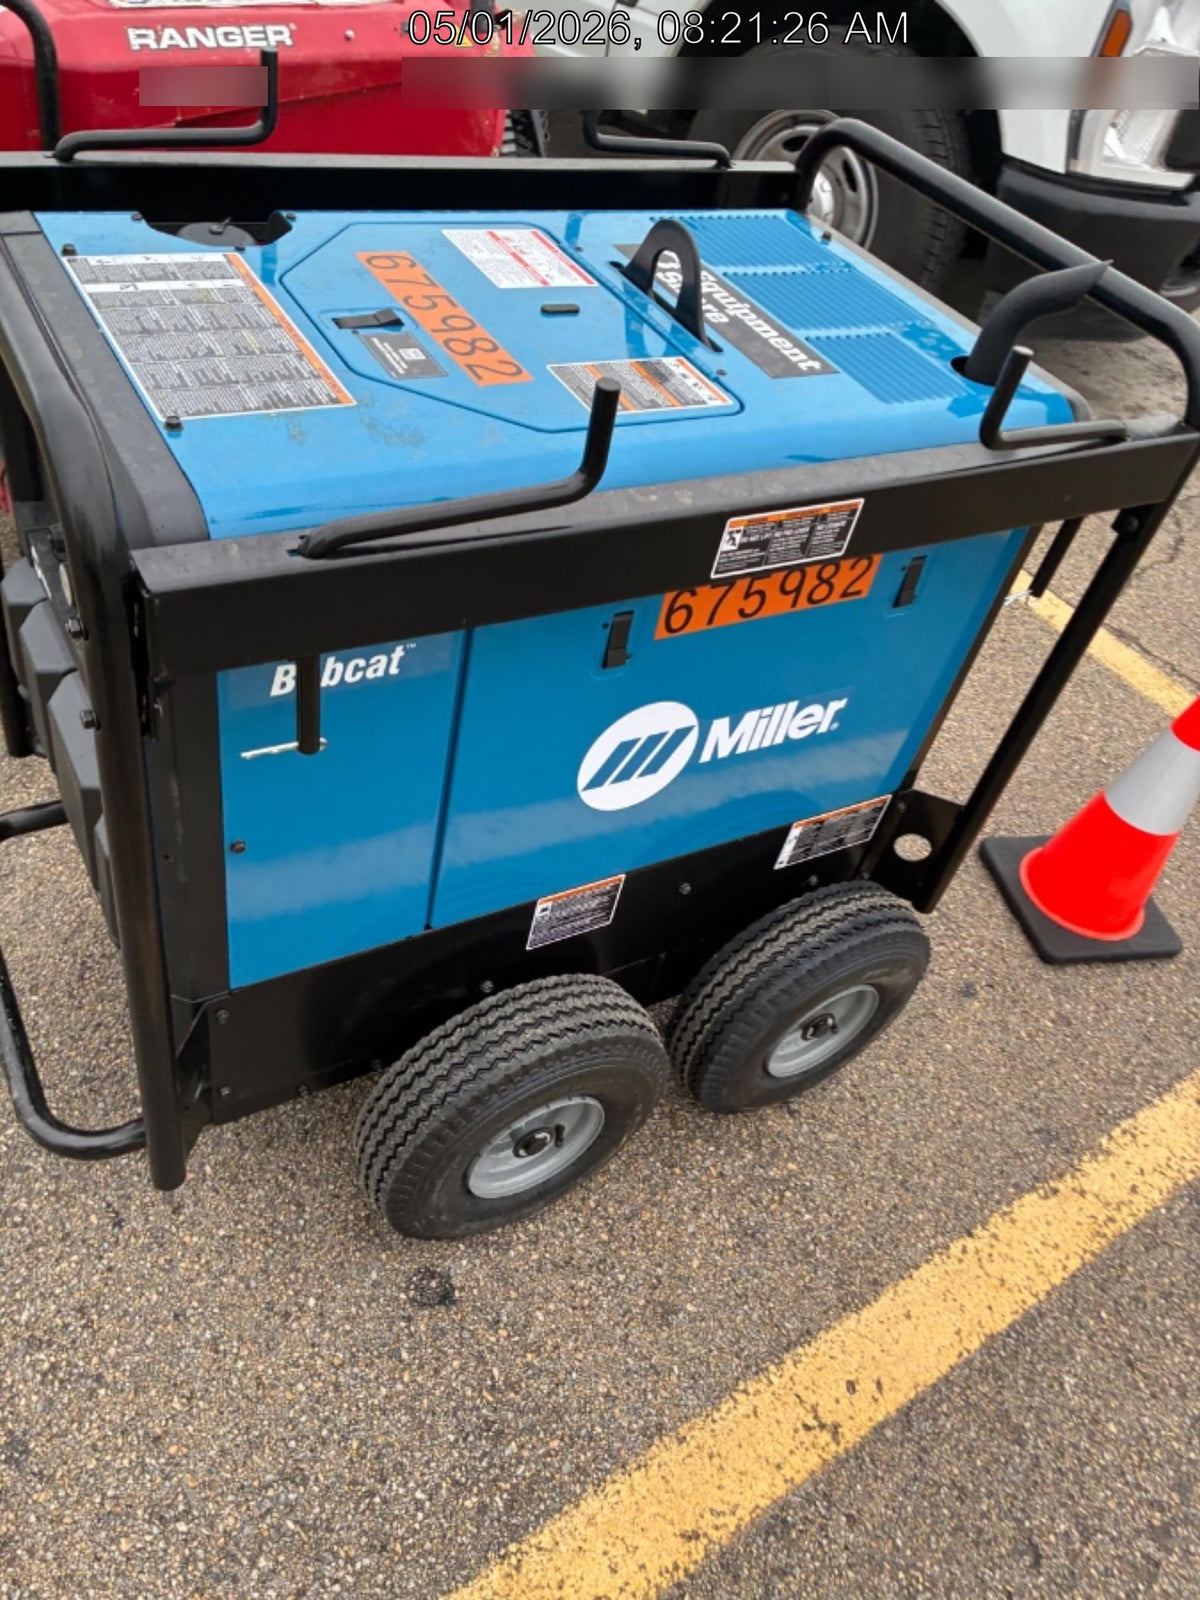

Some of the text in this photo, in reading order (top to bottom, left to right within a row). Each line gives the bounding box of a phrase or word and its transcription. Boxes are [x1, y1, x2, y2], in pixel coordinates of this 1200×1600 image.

[126, 24, 294, 51] RANGER
[365, 254, 524, 381] 675982
[663, 555, 875, 635] 675982
[698, 697, 849, 764] Miller
